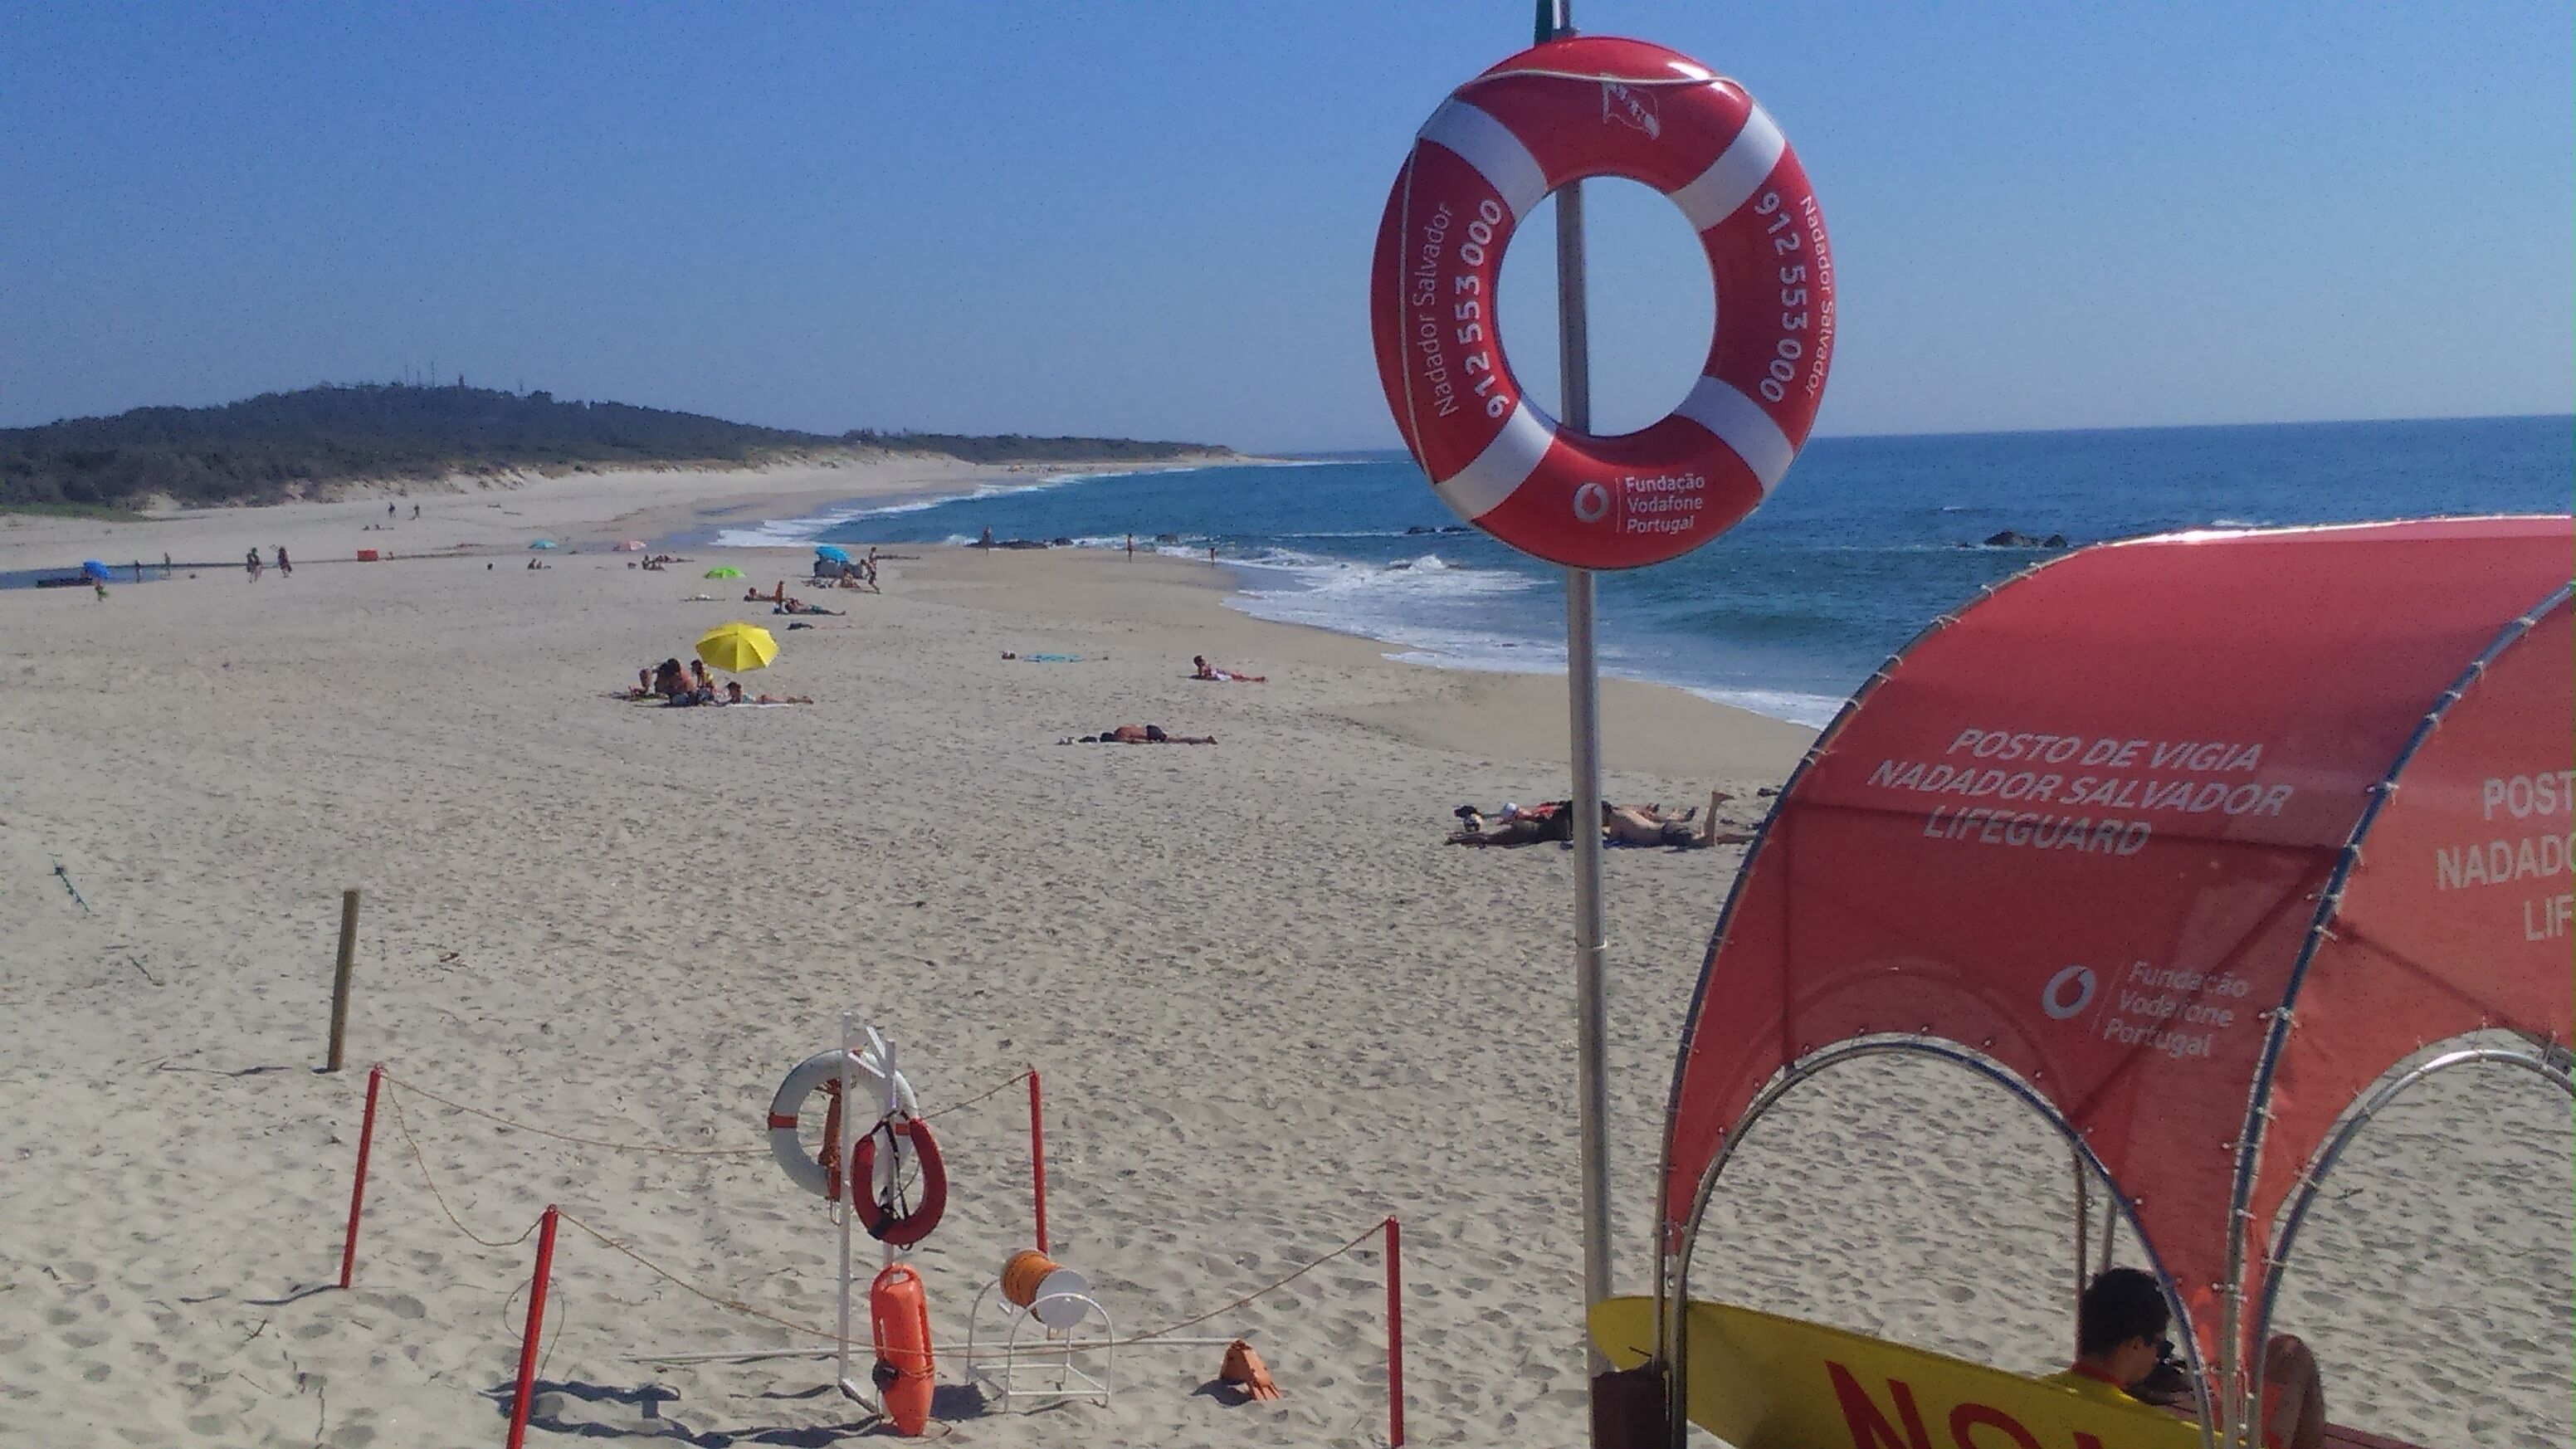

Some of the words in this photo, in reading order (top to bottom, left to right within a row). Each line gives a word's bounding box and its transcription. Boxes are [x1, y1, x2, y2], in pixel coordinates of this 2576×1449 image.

[1412, 203, 1452, 306] Salvador
[1460, 198, 1502, 267] 000
[1754, 192, 1800, 256] 912
[1800, 195, 1832, 295] Nadador
[1454, 275, 1484, 345] 553
[1778, 265, 1808, 330] 553
[1417, 315, 1459, 417] Nadador
[1759, 338, 1803, 403] 000
[1805, 300, 1834, 399] Salvador
[1465, 351, 1510, 417] 912
[1625, 473, 1705, 494] Fundação
[1627, 496, 1703, 514] Vodafone
[1627, 515, 1695, 534] Portugal
[1946, 728, 2082, 764] POSTO
[2080, 737, 2148, 768] DE
[2150, 741, 2263, 772] VIGIA
[1866, 759, 2062, 803] NADADOR
[2058, 776, 2294, 817] SALVADOR
[1923, 804, 2153, 856] LIFEGUARD
[2103, 1017, 2214, 1057] Portugal
